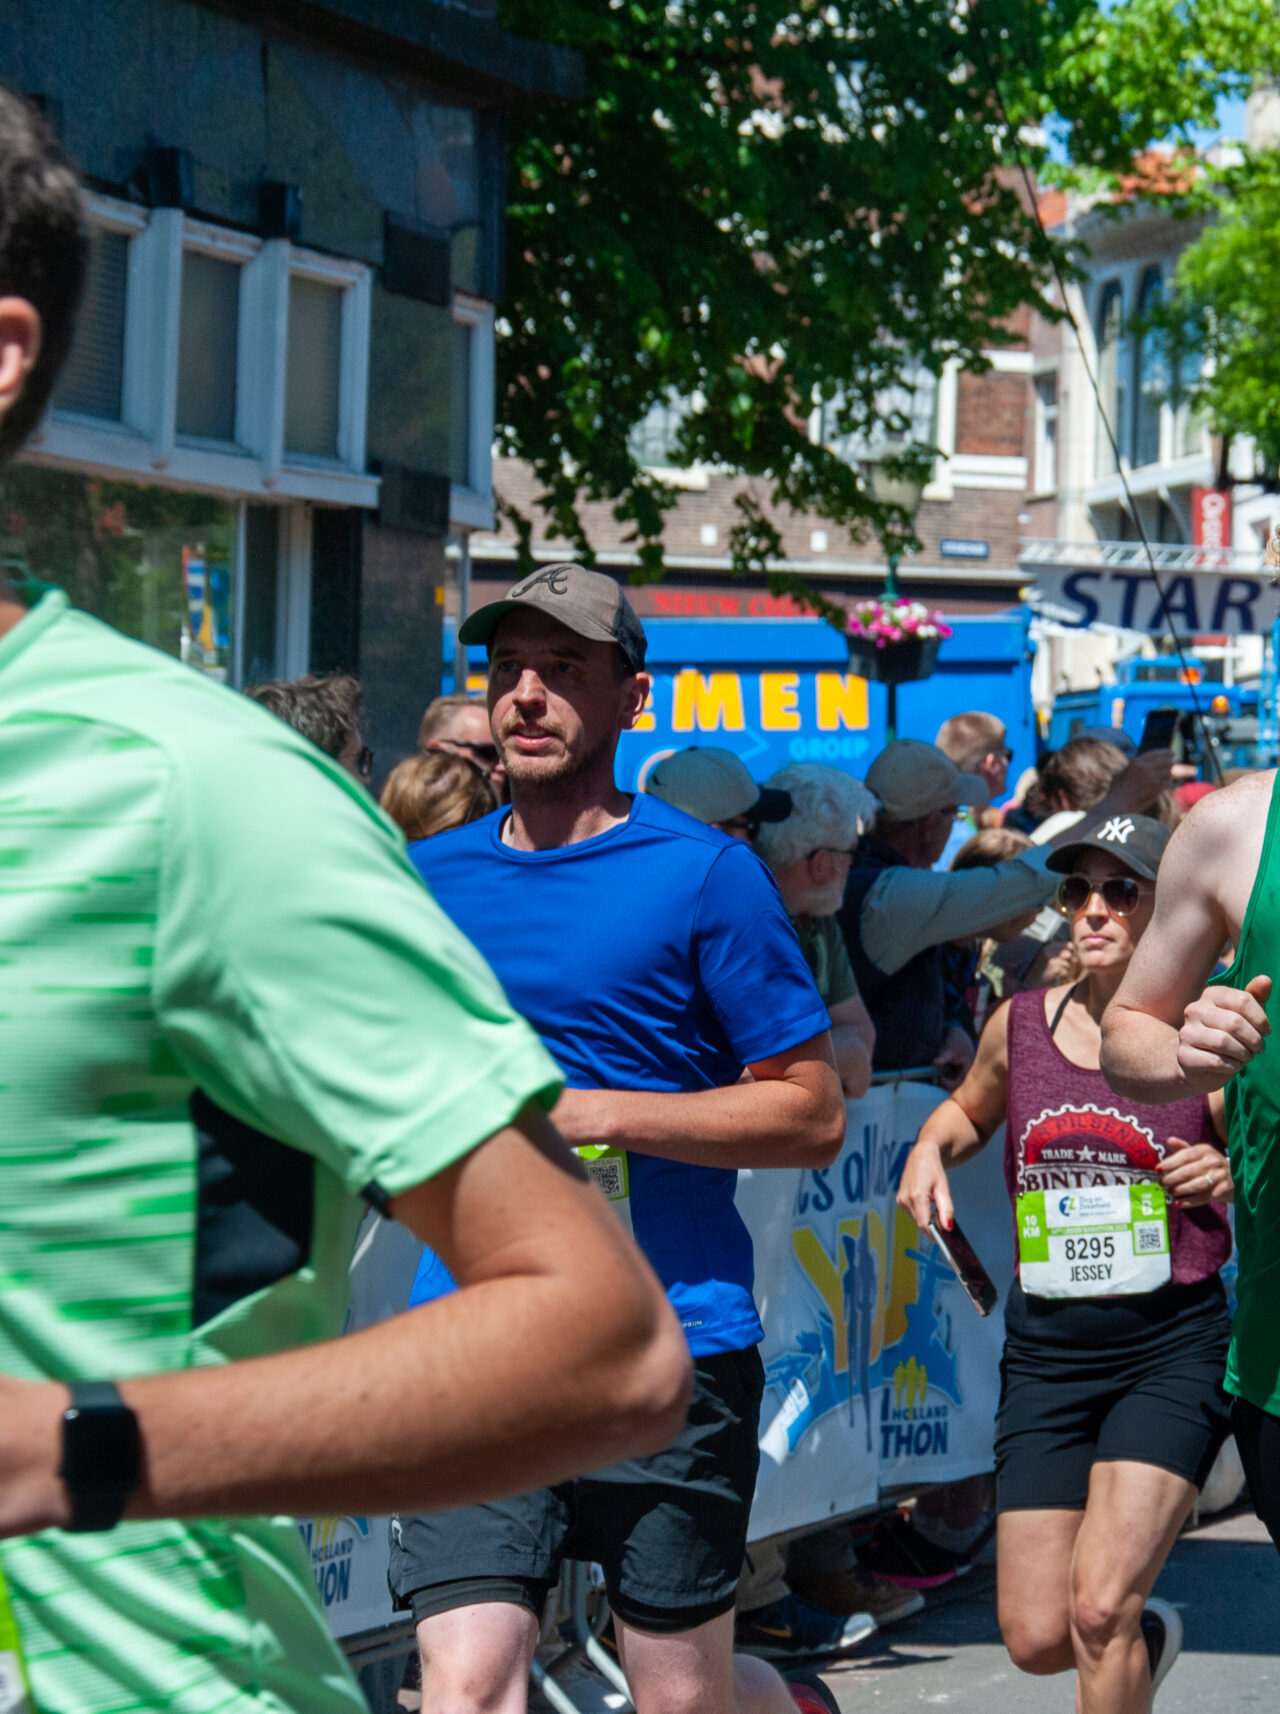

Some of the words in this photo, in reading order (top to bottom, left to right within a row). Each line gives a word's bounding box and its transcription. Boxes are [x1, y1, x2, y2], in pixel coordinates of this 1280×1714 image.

[1059, 569, 1280, 631] STAR
[789, 737, 869, 761] GROEP
[1055, 1116, 1150, 1158] PILSENER
[1041, 1148, 1074, 1160] TRADE
[1098, 1151, 1127, 1164] MARK
[1142, 1200, 1153, 1216] B
[1025, 1215, 1037, 1225] 10
[1023, 1226, 1040, 1238] KM
[1065, 1236, 1115, 1260] 8295
[1070, 1263, 1113, 1282] JESSEY
[881, 1421, 948, 1459] THON
